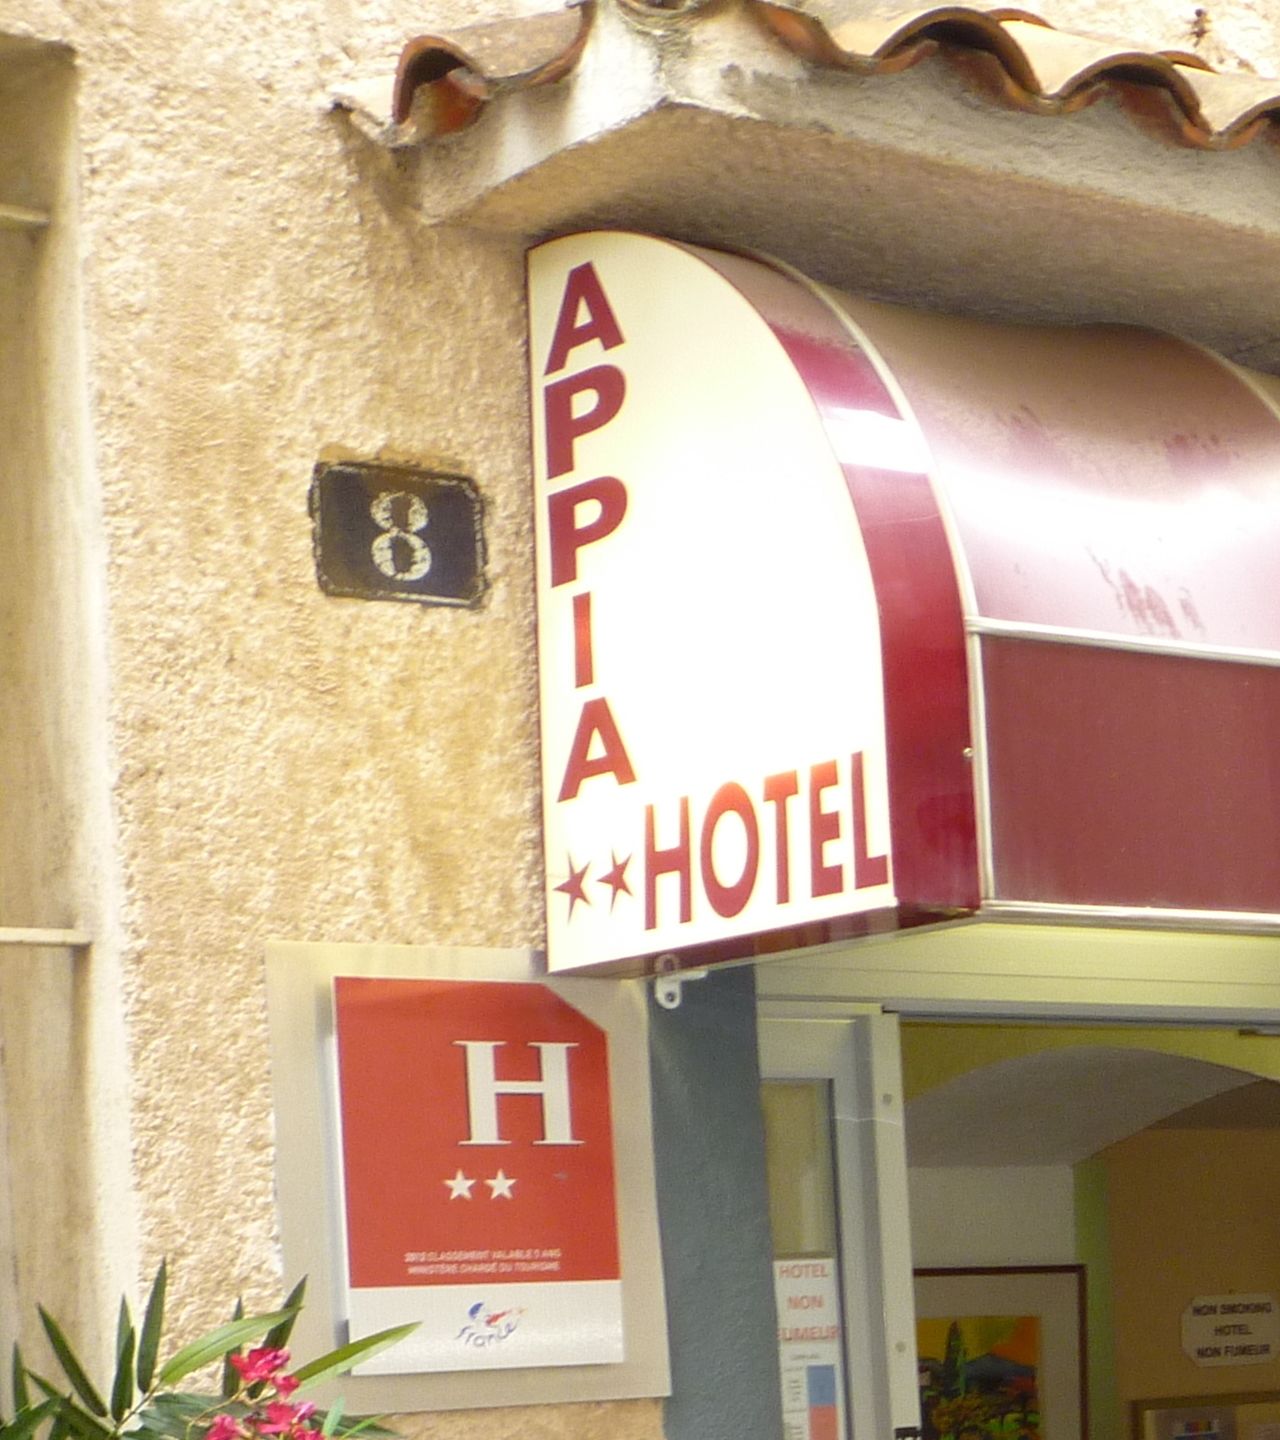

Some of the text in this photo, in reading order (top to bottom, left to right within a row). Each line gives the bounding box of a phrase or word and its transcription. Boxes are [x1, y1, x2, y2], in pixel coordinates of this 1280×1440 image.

[369, 490, 432, 582] 8
[543, 261, 637, 804] APPIA
[643, 750, 890, 931] HOTEL
[451, 1039, 585, 1146] H
[779, 1263, 829, 1279] HOTEL
[788, 1294, 824, 1310] NON
[1193, 1302, 1273, 1316] NON SMOKING
[1214, 1324, 1253, 1336] HOTEL
[1197, 1344, 1271, 1358] NON FUMEUR
